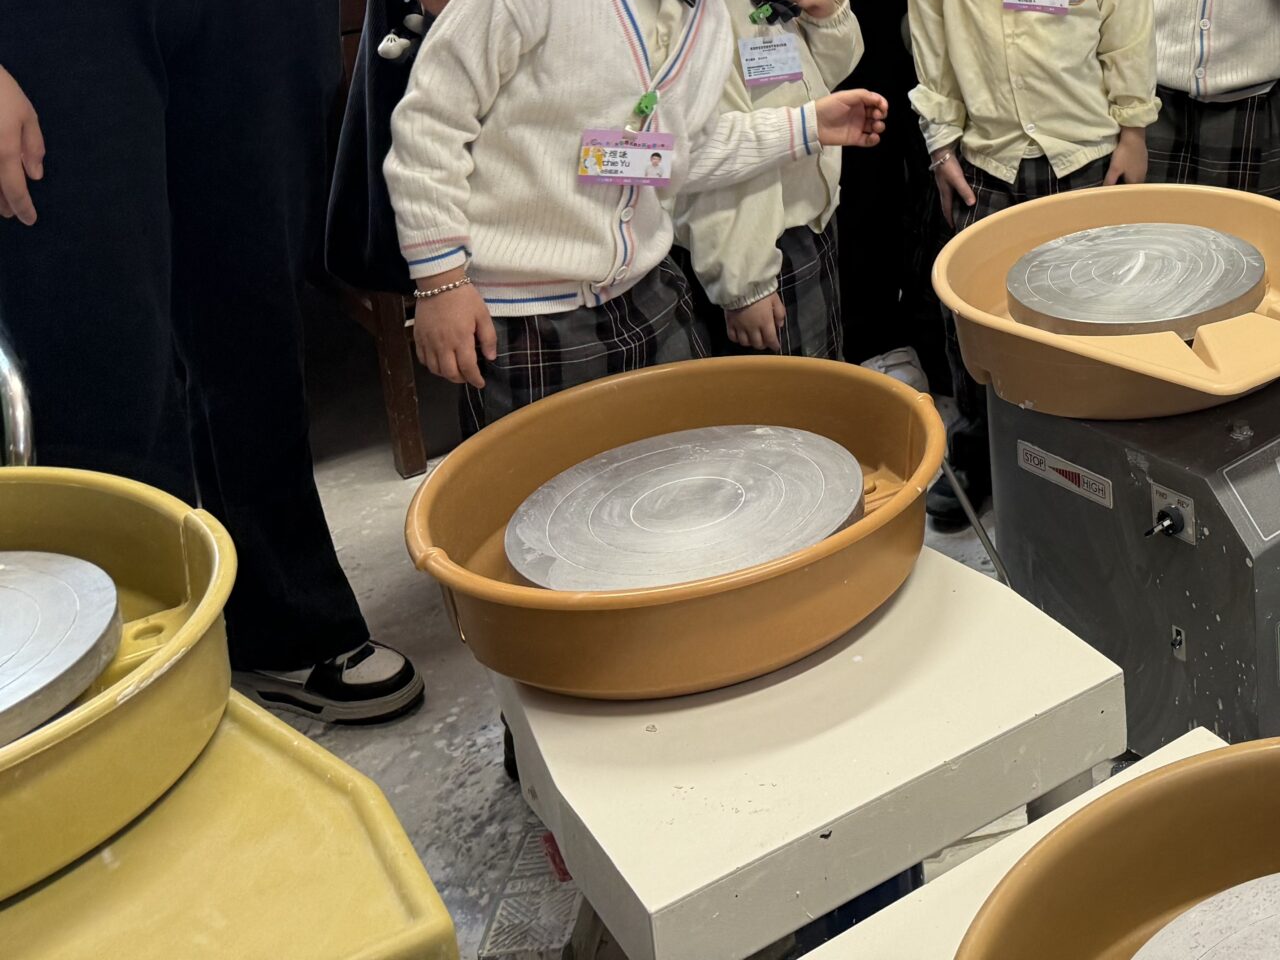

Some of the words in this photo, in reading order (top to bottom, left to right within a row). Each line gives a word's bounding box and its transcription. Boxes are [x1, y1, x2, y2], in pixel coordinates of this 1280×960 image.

[620, 159, 630, 168] Yu
[1024, 451, 1045, 469] STOP
[1083, 476, 1105, 497] HIGH
[1177, 499, 1190, 509] REV
